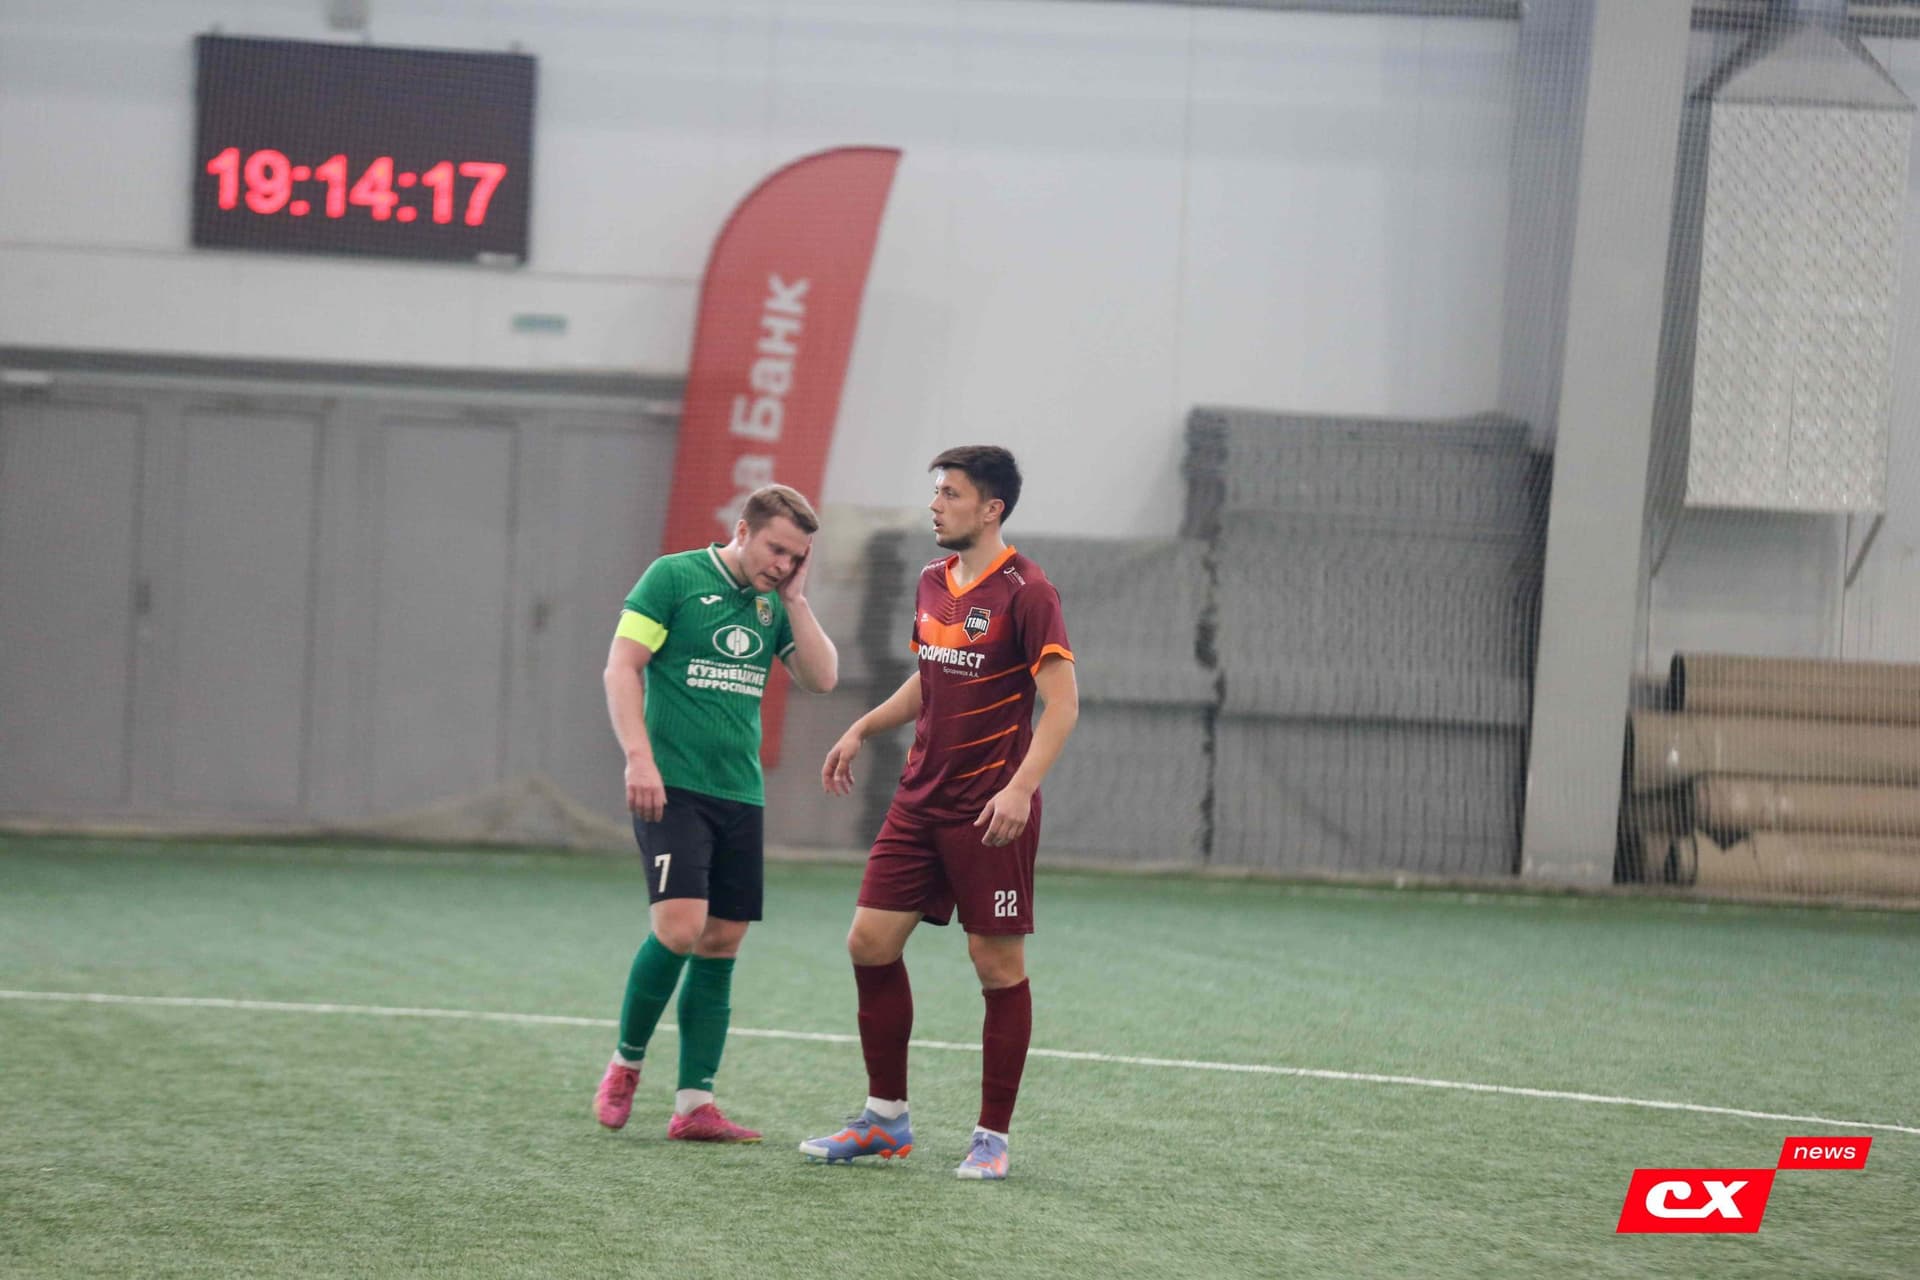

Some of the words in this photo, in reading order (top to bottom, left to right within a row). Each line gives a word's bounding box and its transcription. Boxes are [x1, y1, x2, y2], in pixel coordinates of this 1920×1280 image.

[206, 147, 508, 227] 19:14:17
[728, 272, 811, 444] Банк
[967, 617, 987, 631] ТЕМП
[687, 664, 766, 685] КУЗНЕЦКИЕ
[654, 853, 671, 893] 7
[994, 890, 1018, 917] 22
